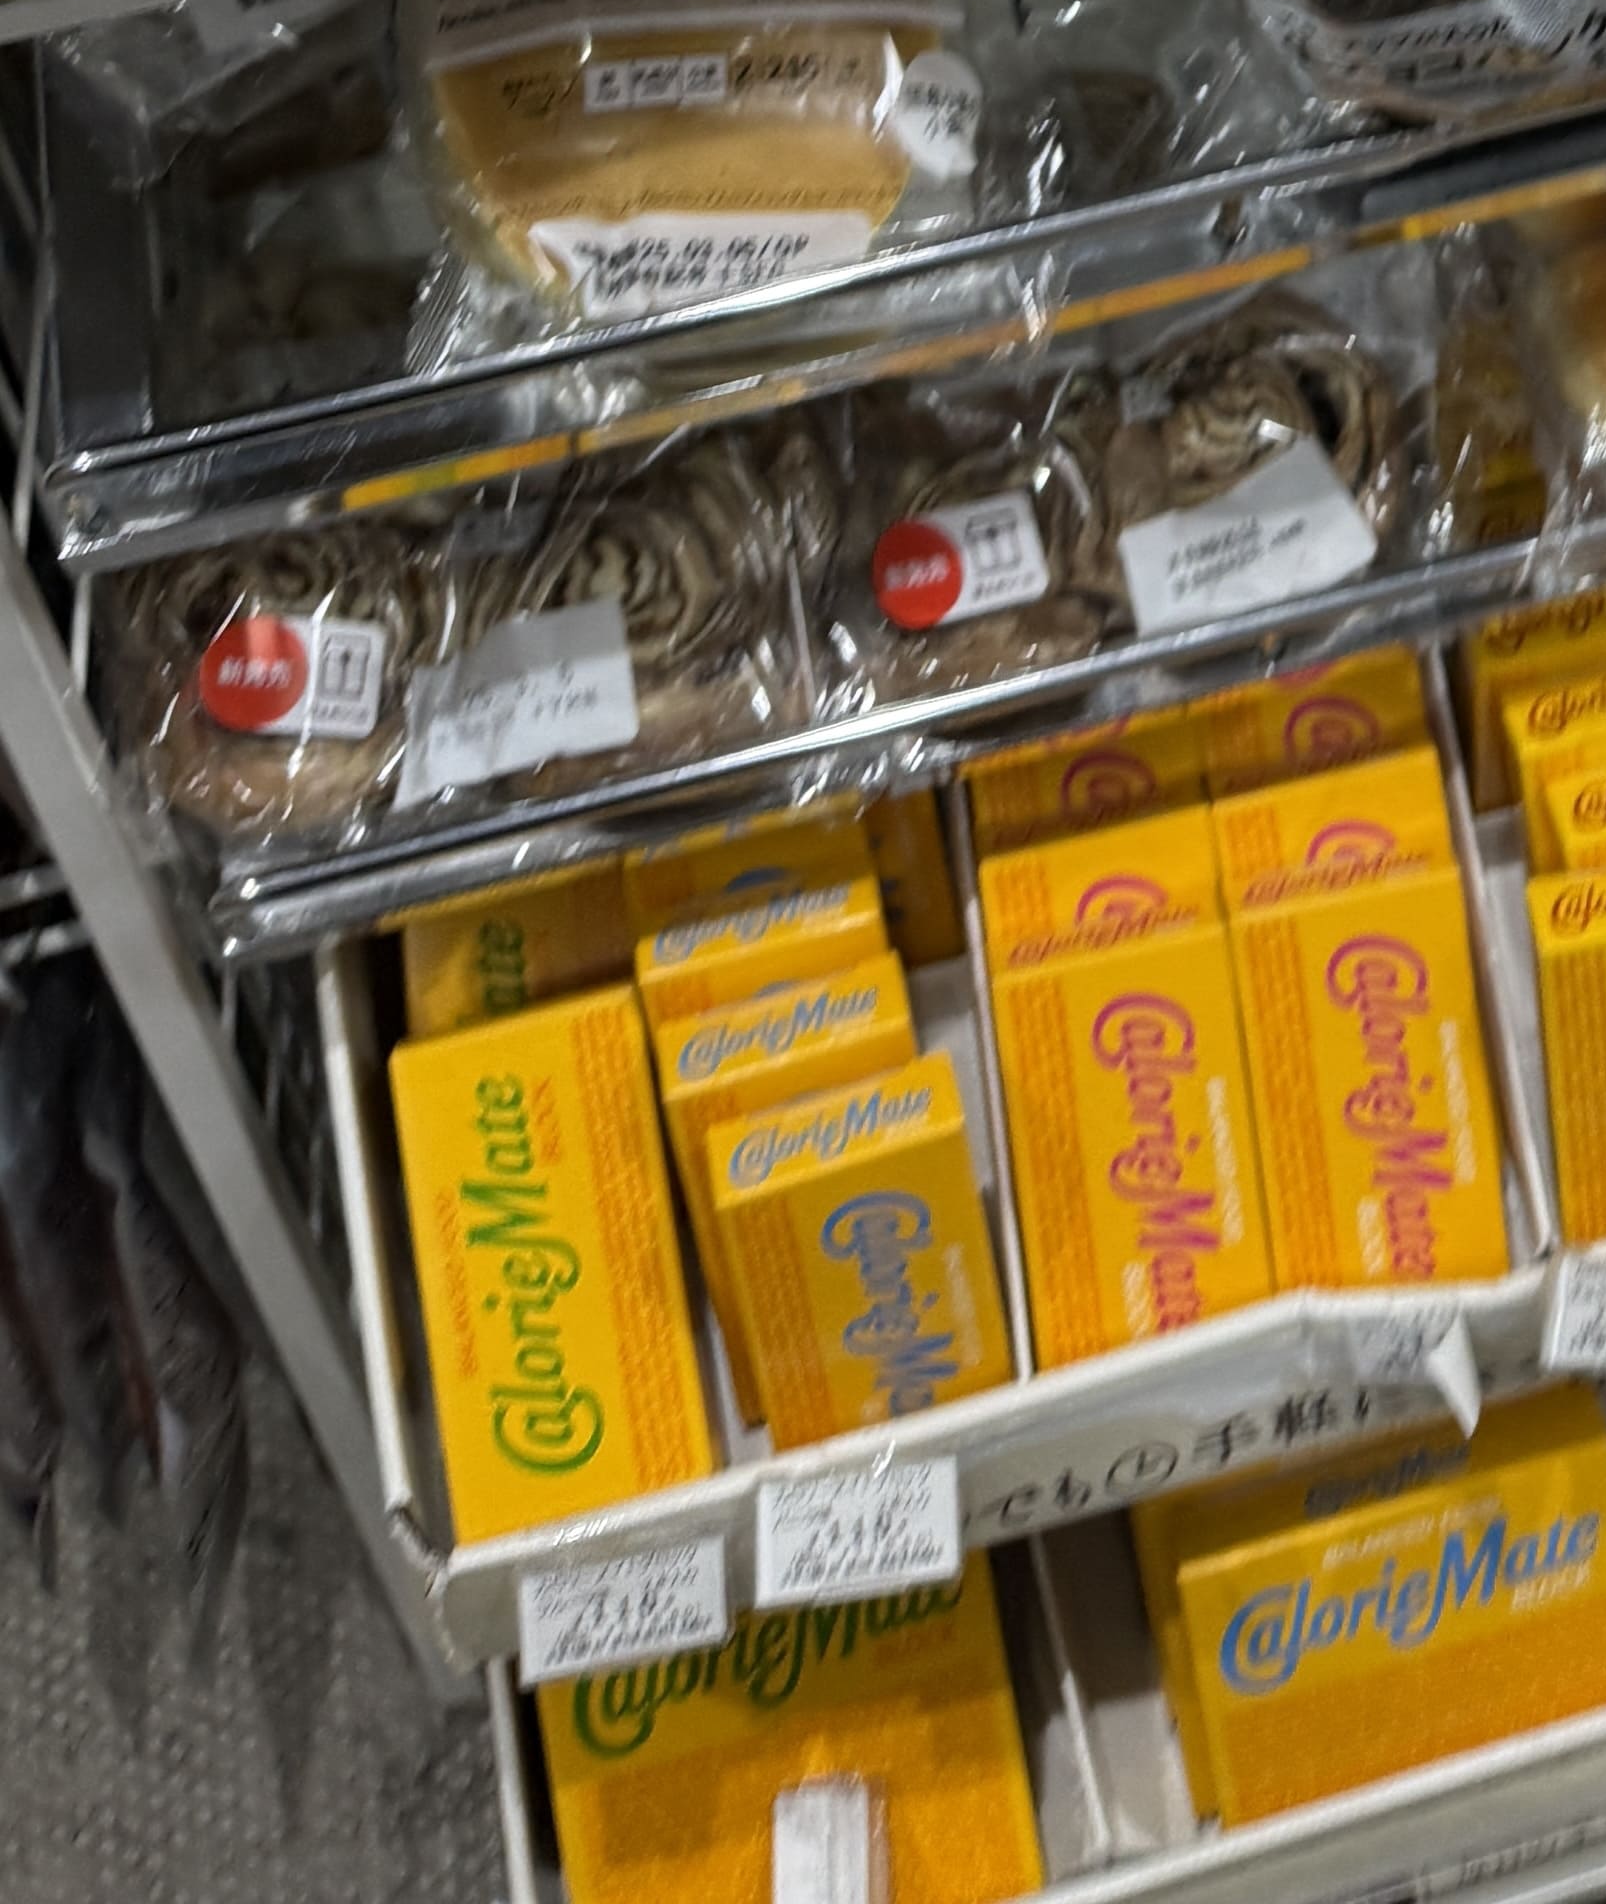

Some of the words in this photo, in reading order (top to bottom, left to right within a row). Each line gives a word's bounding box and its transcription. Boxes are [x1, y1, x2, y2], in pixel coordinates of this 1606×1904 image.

[217, 656, 293, 690] 新発売
[652, 884, 850, 962] CalorieMate
[678, 985, 879, 1082] CalorieMate
[728, 1083, 932, 1188] CalorieMate
[1325, 934, 1453, 1279] CalorieMate
[460, 1069, 606, 1478] CalorieMate
[1219, 1510, 1600, 1695] CalorieMate
